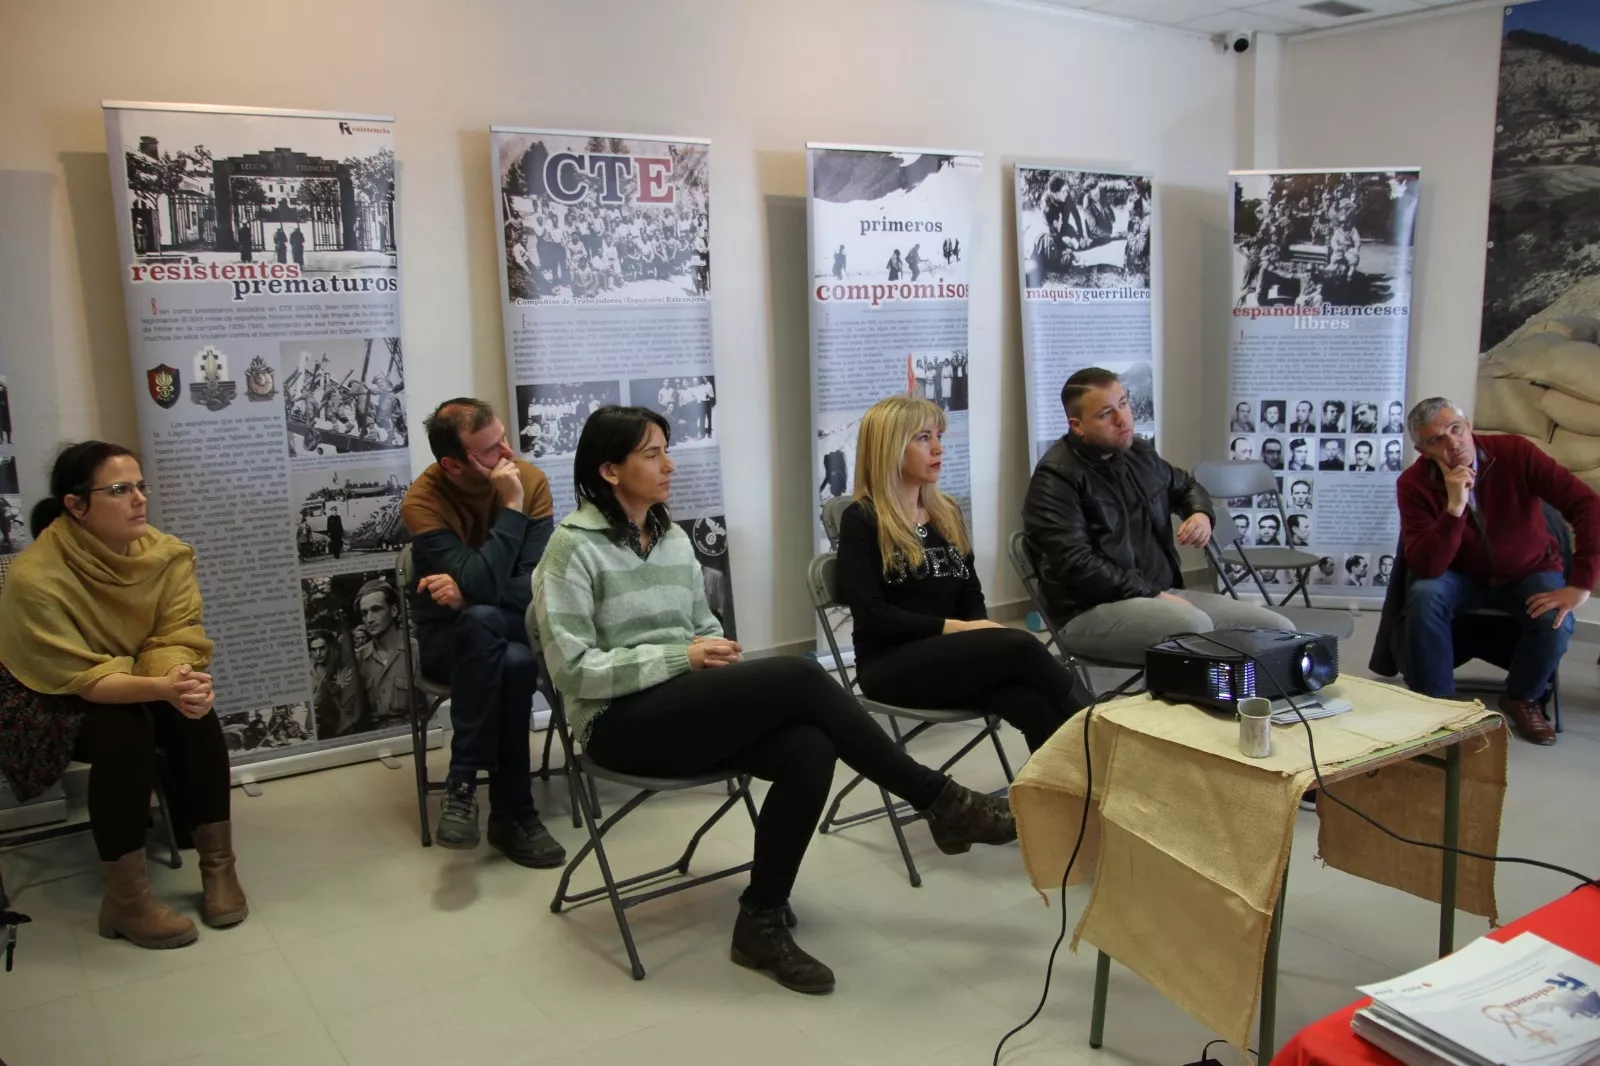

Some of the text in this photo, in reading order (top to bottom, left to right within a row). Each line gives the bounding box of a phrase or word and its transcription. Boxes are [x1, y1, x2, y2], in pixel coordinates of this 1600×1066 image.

[546, 153, 673, 203] CTE
[860, 216, 943, 236] primeros
[131, 257, 300, 281] resistentes
[233, 274, 398, 300] prematuros
[1293, 317, 1350, 330] libres
